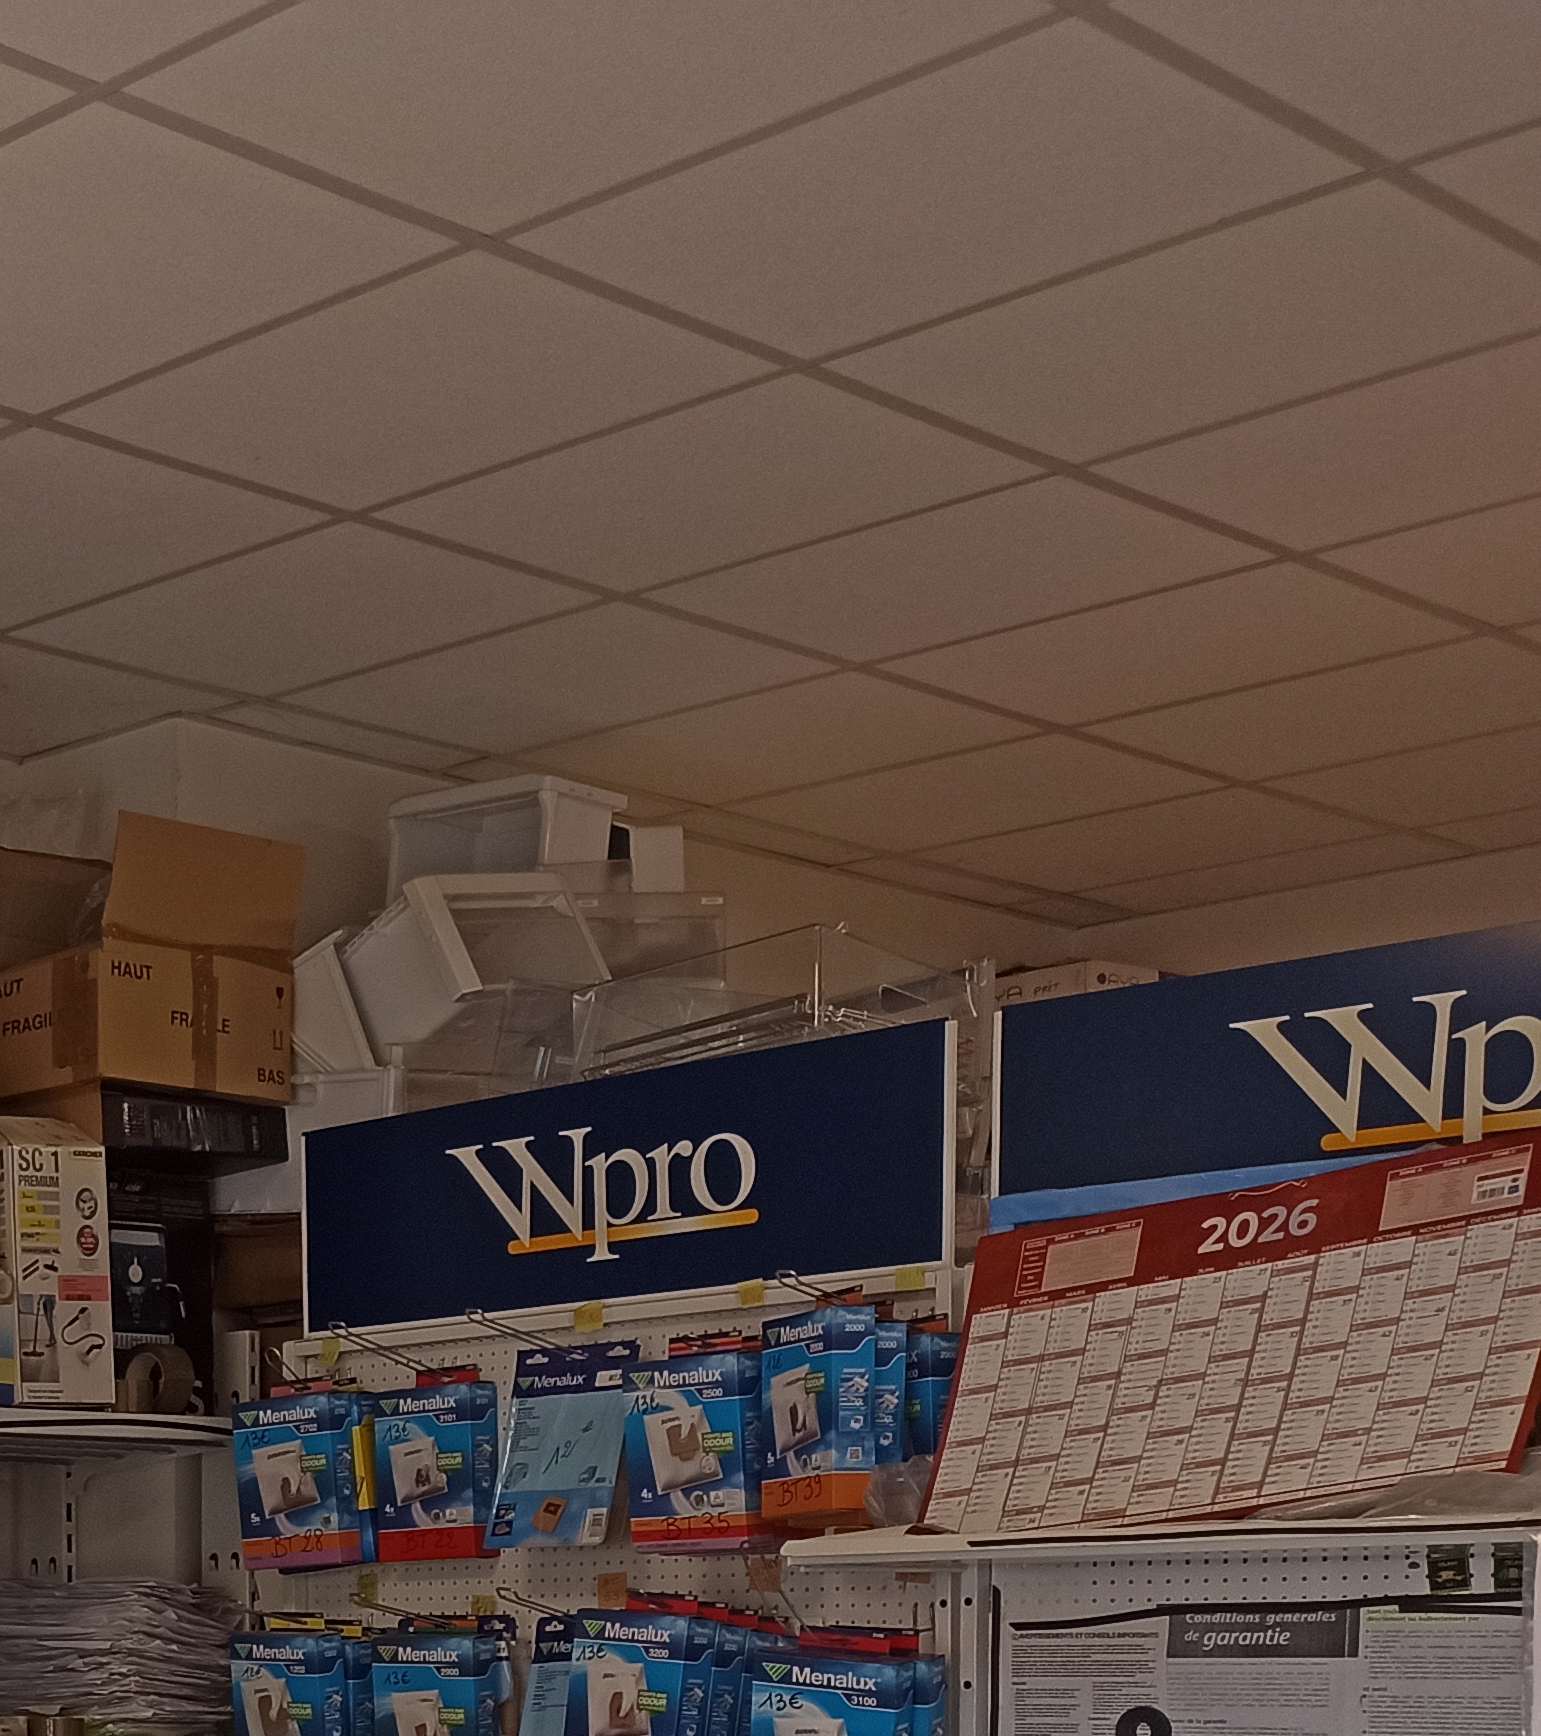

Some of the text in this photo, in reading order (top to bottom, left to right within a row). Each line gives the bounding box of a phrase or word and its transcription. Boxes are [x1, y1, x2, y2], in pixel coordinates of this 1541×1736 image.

[110, 960, 152, 981] HAUT
[257, 1068, 285, 1085] BAS
[18, 1147, 59, 1173] SC 1
[19, 1175, 59, 1188] PREMIUM
[445, 1126, 758, 1263] Wpro
[1197, 1198, 1320, 1255] 2026
[653, 1367, 722, 1387] Menalux
[1185, 1626, 1290, 1649] de garantie
[792, 1667, 877, 1707] Menalux 3100
